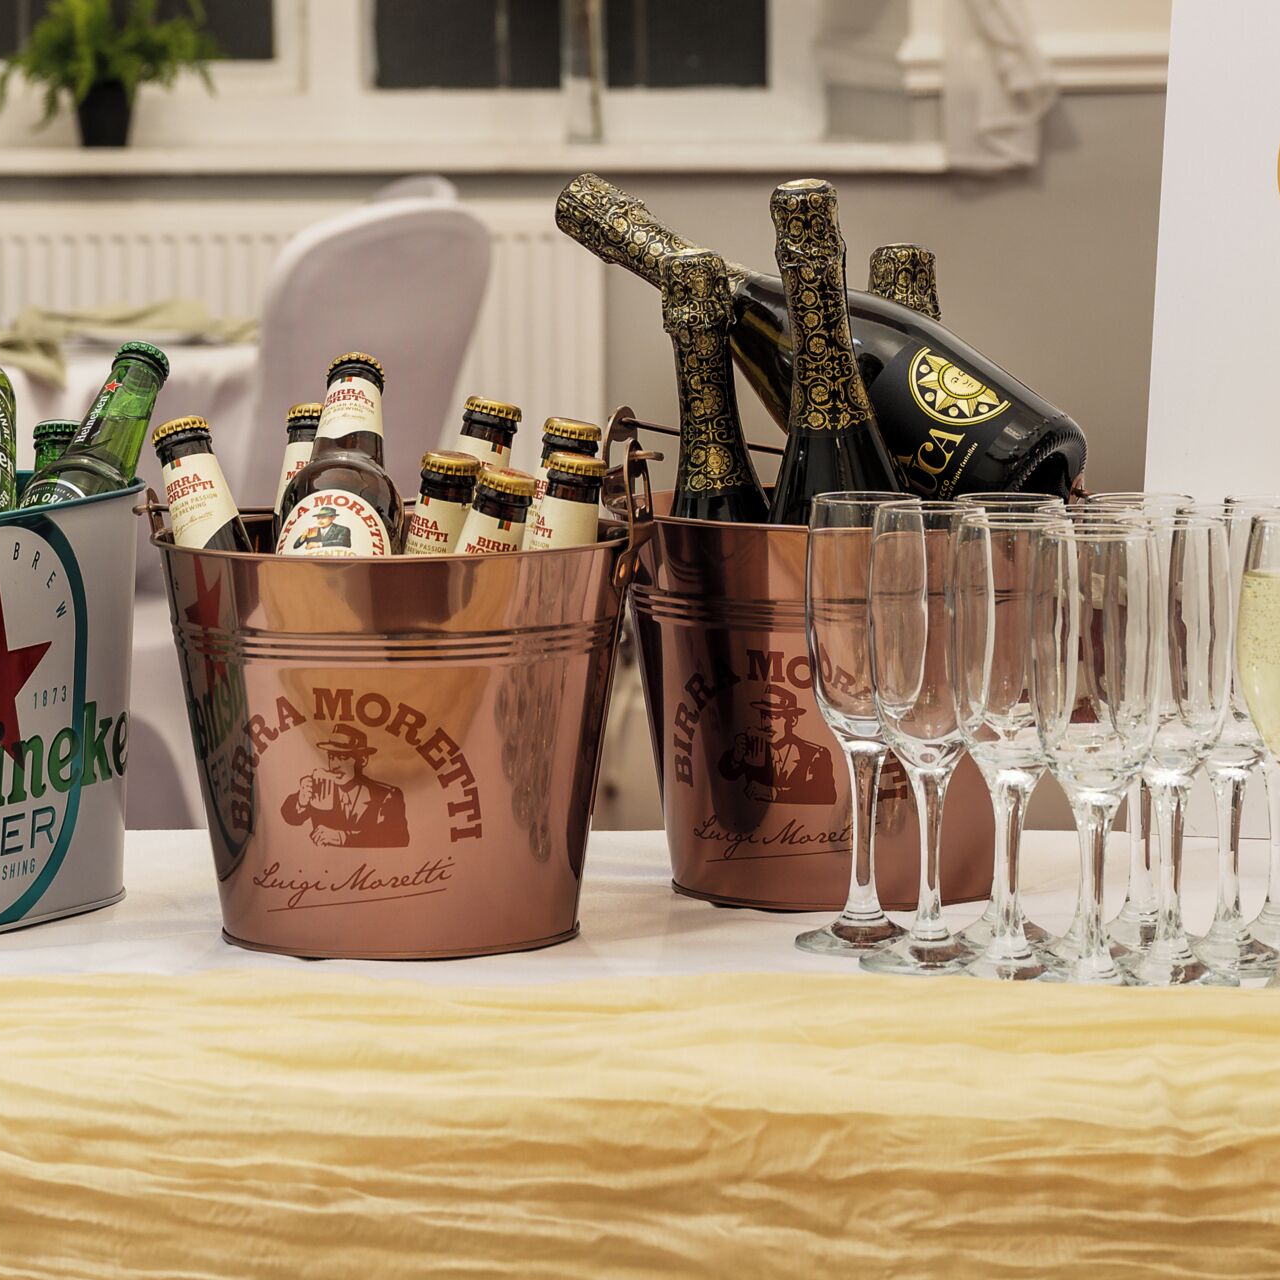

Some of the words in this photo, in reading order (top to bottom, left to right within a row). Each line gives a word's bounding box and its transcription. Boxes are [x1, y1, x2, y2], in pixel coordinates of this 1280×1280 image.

[74, 394, 110, 443] Heineken
[324, 394, 375, 409] ORETTI
[166, 473, 202, 496] BIRRA
[166, 480, 215, 506] ORETTI
[313, 494, 385, 556] MORETT
[476, 536, 518, 553] BIRRA
[13, 541, 68, 619] BREW
[33, 684, 69, 711] 1873
[673, 658, 741, 788] BIRRA
[231, 695, 308, 834] BIRRA
[312, 687, 483, 843] MORETTI
[693, 814, 761, 860] Luigi
[253, 861, 329, 909] Luigi
[330, 856, 456, 892] Moretti
